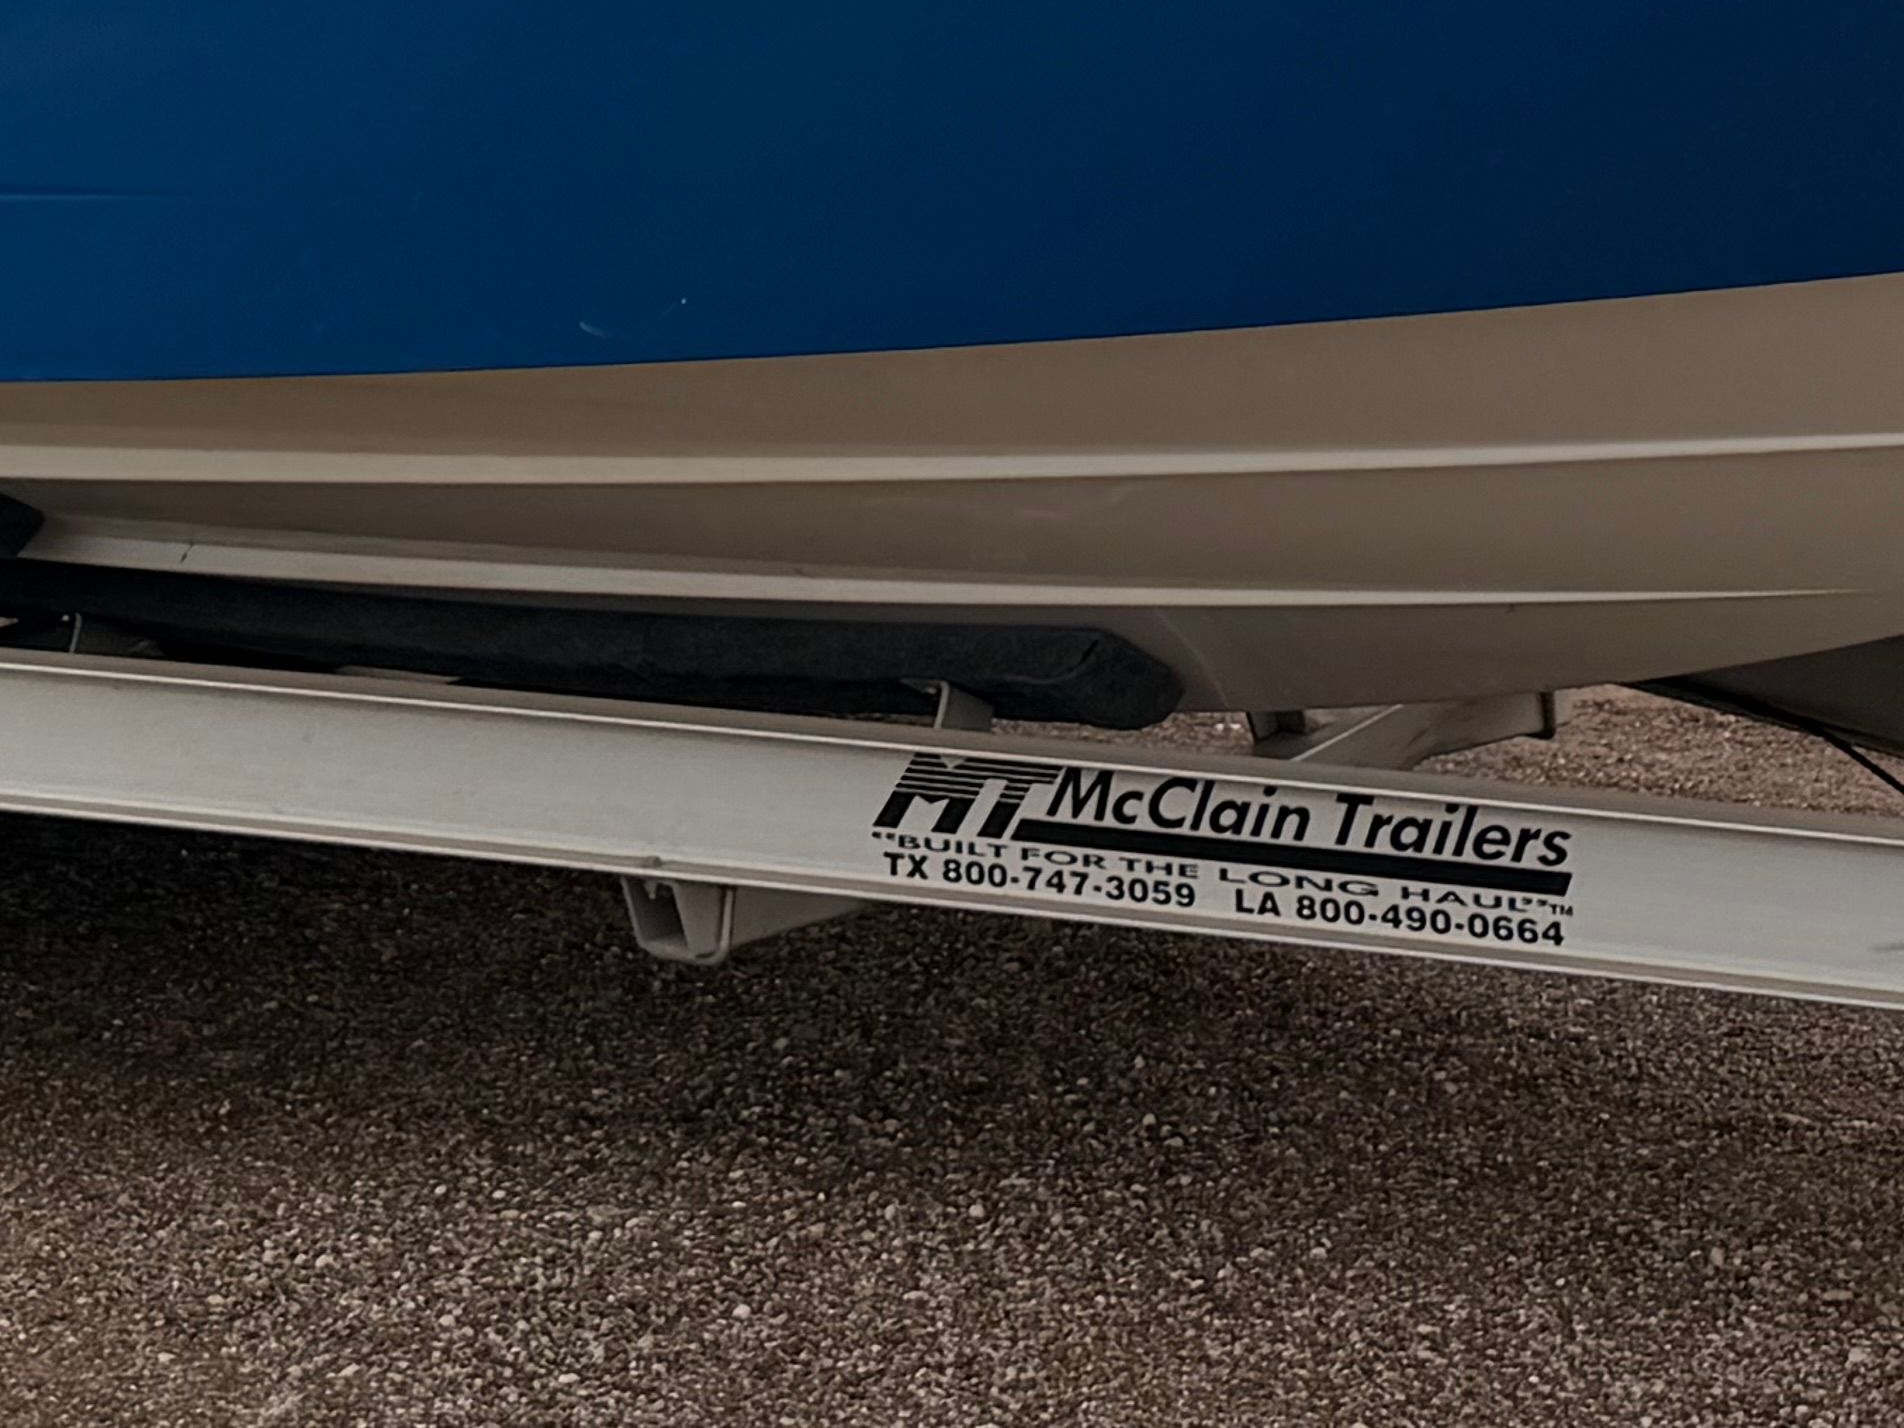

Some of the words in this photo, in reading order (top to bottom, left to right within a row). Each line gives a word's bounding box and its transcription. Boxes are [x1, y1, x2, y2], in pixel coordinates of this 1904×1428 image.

[1046, 766, 1311, 842] McClain
[1335, 792, 1572, 867] Trailers
[883, 851, 929, 880] TX
[941, 858, 1196, 908] 800-747-3059
[1234, 888, 1282, 918] LA
[1295, 894, 1564, 947] 800-490-0664
[1020, 847, 1107, 870] FOR
[1118, 856, 1199, 879] THE
[1219, 867, 1380, 897] LONG
